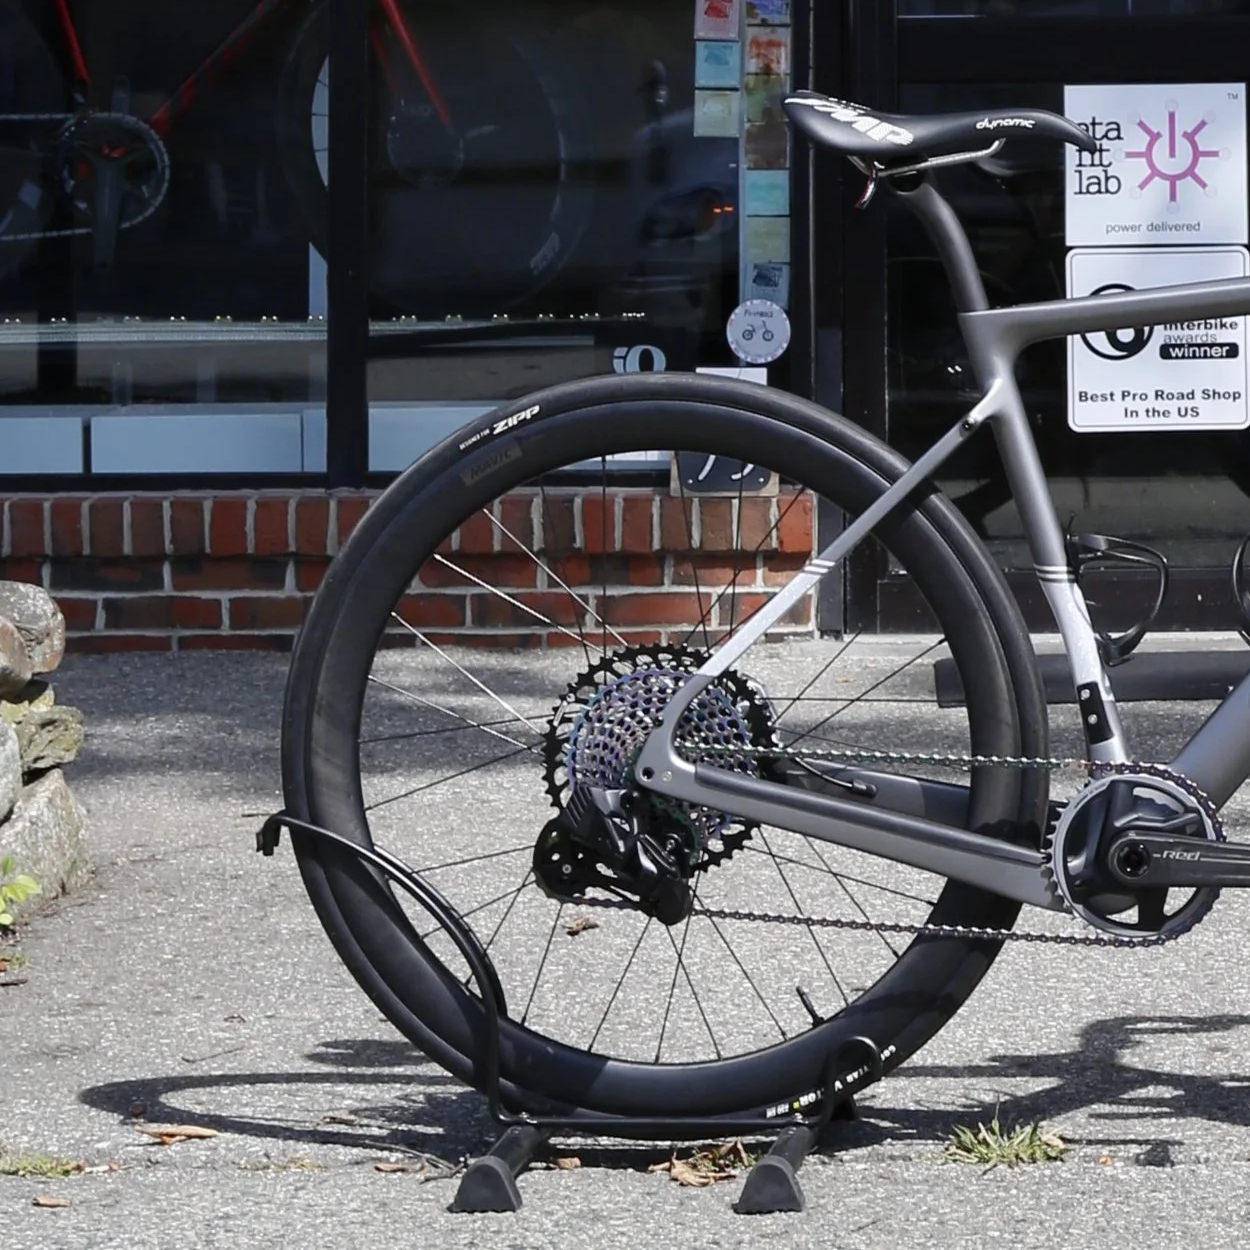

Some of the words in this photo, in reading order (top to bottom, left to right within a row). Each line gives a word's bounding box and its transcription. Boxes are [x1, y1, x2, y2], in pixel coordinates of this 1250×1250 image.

[976, 117, 1036, 131] dynamic
[1073, 169, 1122, 195] lab
[1106, 223, 1142, 234] power
[1146, 221, 1201, 232] delivered
[1163, 332, 1217, 343] awards
[1169, 345, 1230, 358] winner
[1078, 390, 1116, 402] Best
[1121, 390, 1149, 402] Pro
[1154, 389, 1196, 401] Road
[1201, 388, 1242, 402] Shop
[1124, 408, 1139, 418] In
[1145, 407, 1171, 418] the
[1177, 406, 1200, 418] US
[493, 404, 540, 435] ZIPP
